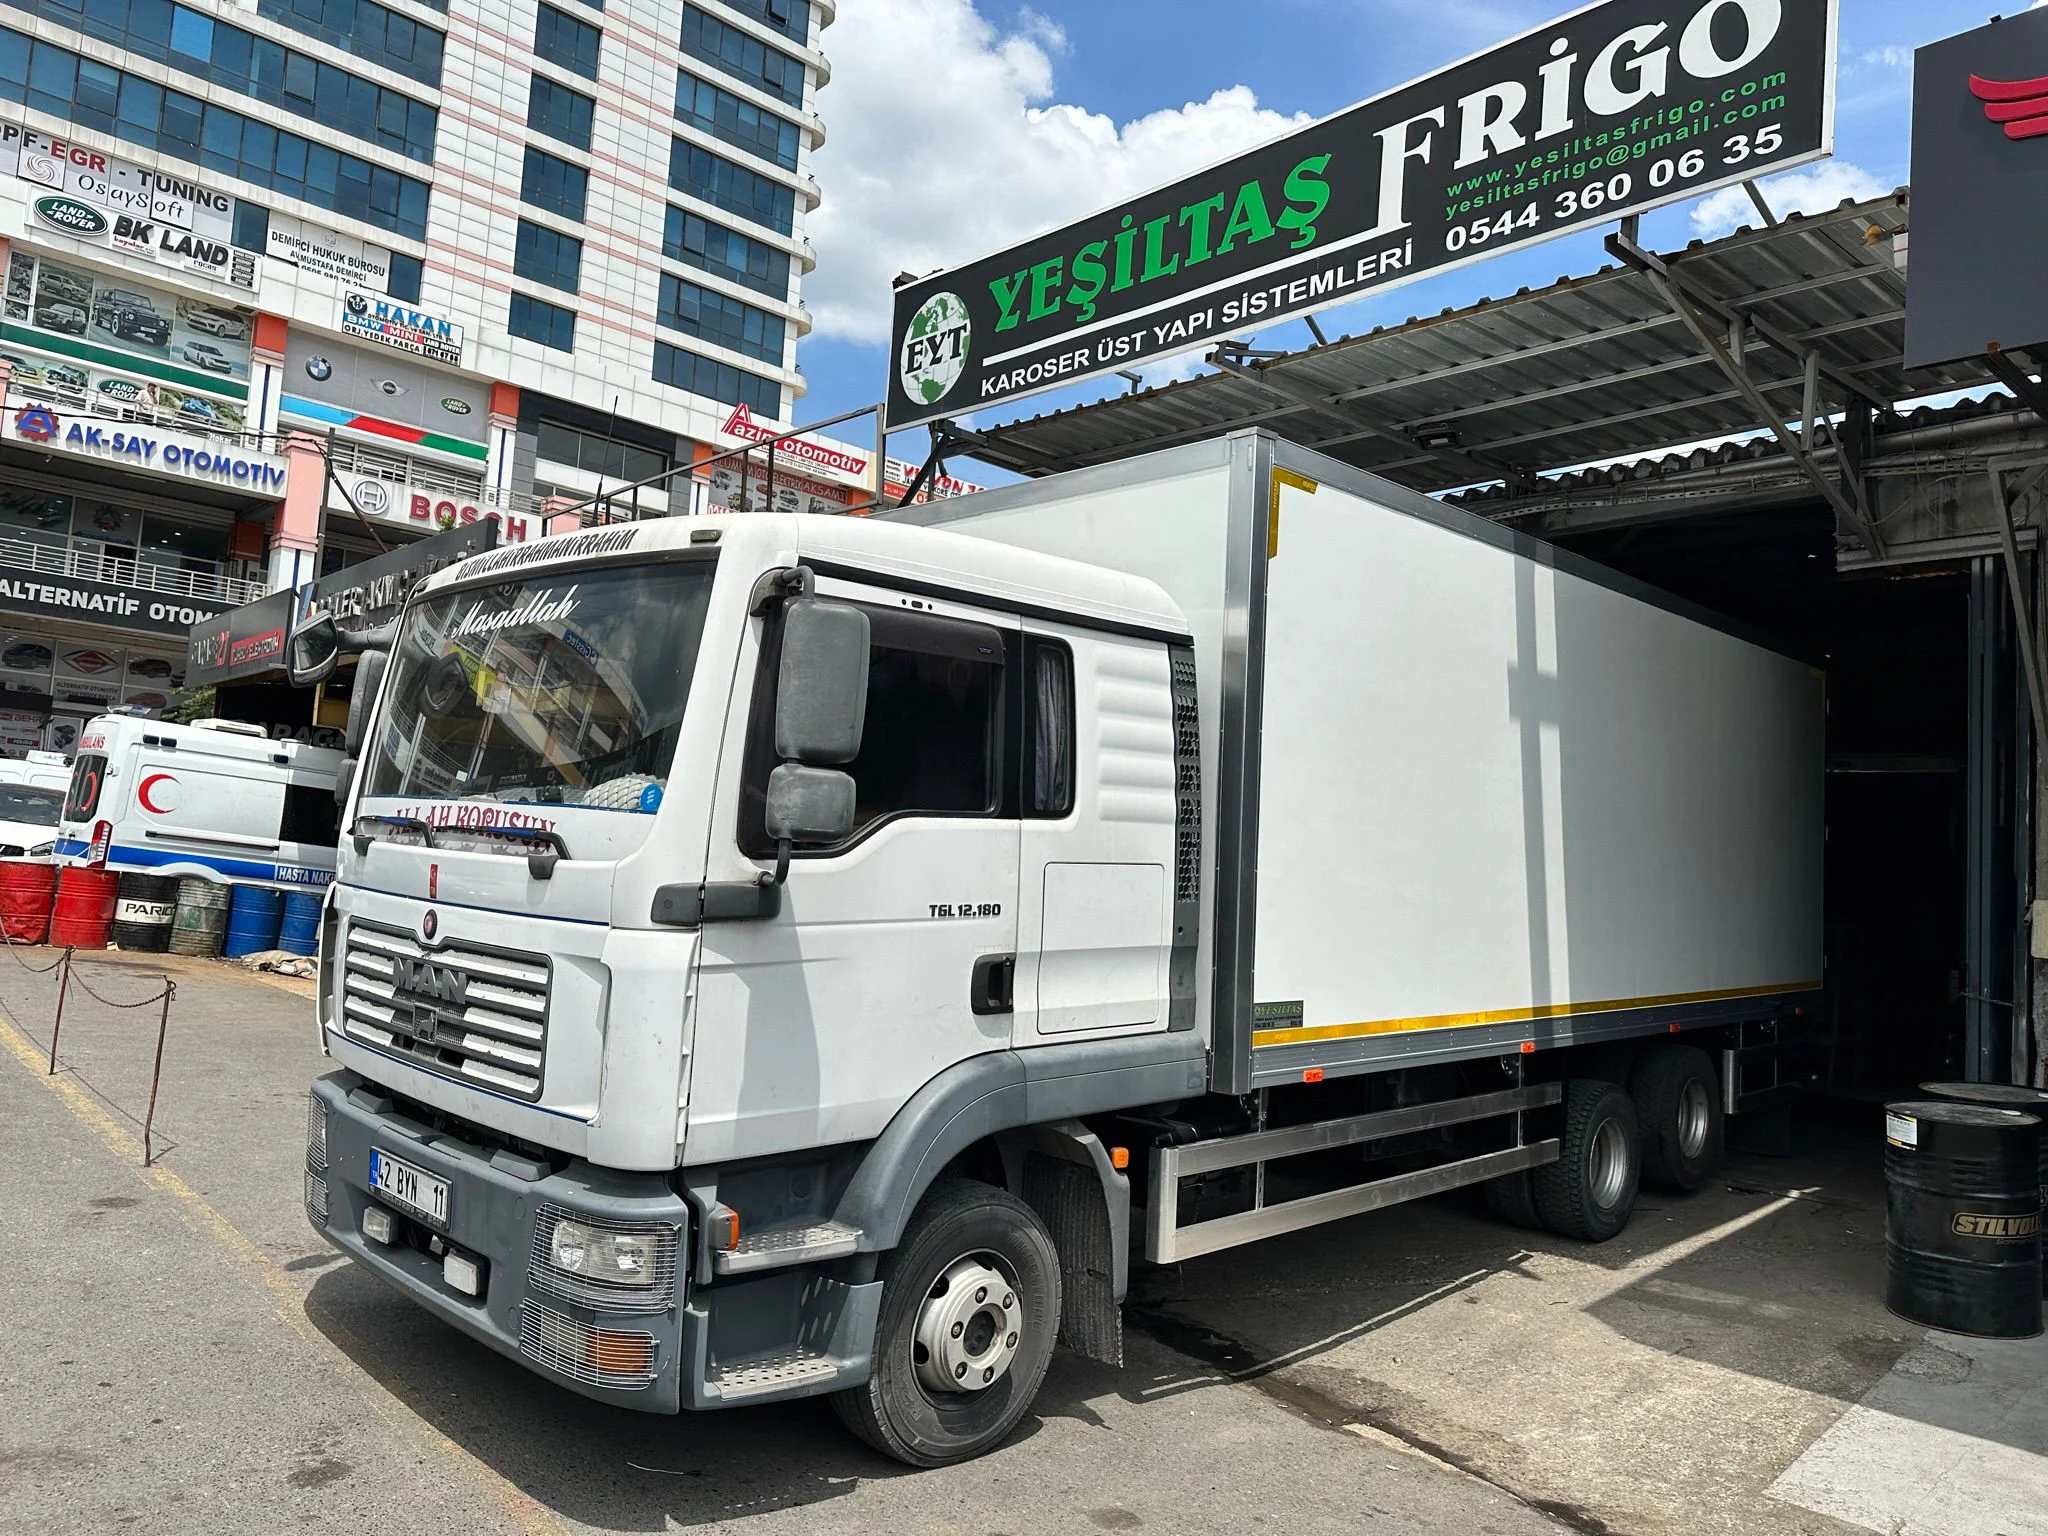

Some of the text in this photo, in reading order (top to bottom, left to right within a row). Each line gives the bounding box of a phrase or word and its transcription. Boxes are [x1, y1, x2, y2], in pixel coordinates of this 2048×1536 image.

[1373, 0, 1782, 233] FRİGO
[1446, 70, 1786, 198] www.yesiltasfrigo.com
[0, 124, 106, 174] PF-EGR
[138, 168, 229, 212] TUNING
[1445, 93, 1785, 220] yesiltasfrigo@gmail.com
[51, 201, 87, 221] LAND
[1445, 123, 1783, 252] 0544 360 06 35
[54, 212, 96, 230] ROVER
[113, 215, 229, 266] BK LAND
[988, 152, 1332, 333] YEŞİLTAŞ
[313, 245, 346, 265] HUKUK
[348, 256, 385, 277] BÜROSU
[347, 313, 381, 331] BMW
[389, 326, 418, 342] MINI
[441, 341, 460, 354] ROVER
[375, 300, 451, 337] HAKAN
[980, 238, 1413, 397] KAROSER ÜST YAPI SİSTEMLERİ
[904, 323, 968, 378] EYT
[108, 381, 134, 394] LAND
[110, 388, 137, 400] ROVE
[446, 398, 462, 407] LAND
[448, 404, 467, 413] ROVER
[66, 423, 285, 487] AK-SAY OTOMOTİV
[784, 440, 862, 473] otomotiv
[0, 578, 222, 625] ALTERNATİF OTOM
[279, 867, 309, 883] HASTA
[929, 903, 1001, 917] TGL 12.180
[393, 956, 467, 1004] MAN
[378, 1158, 391, 1189] 42
[397, 1167, 418, 1203] BYN
[434, 1184, 444, 1217] 11
